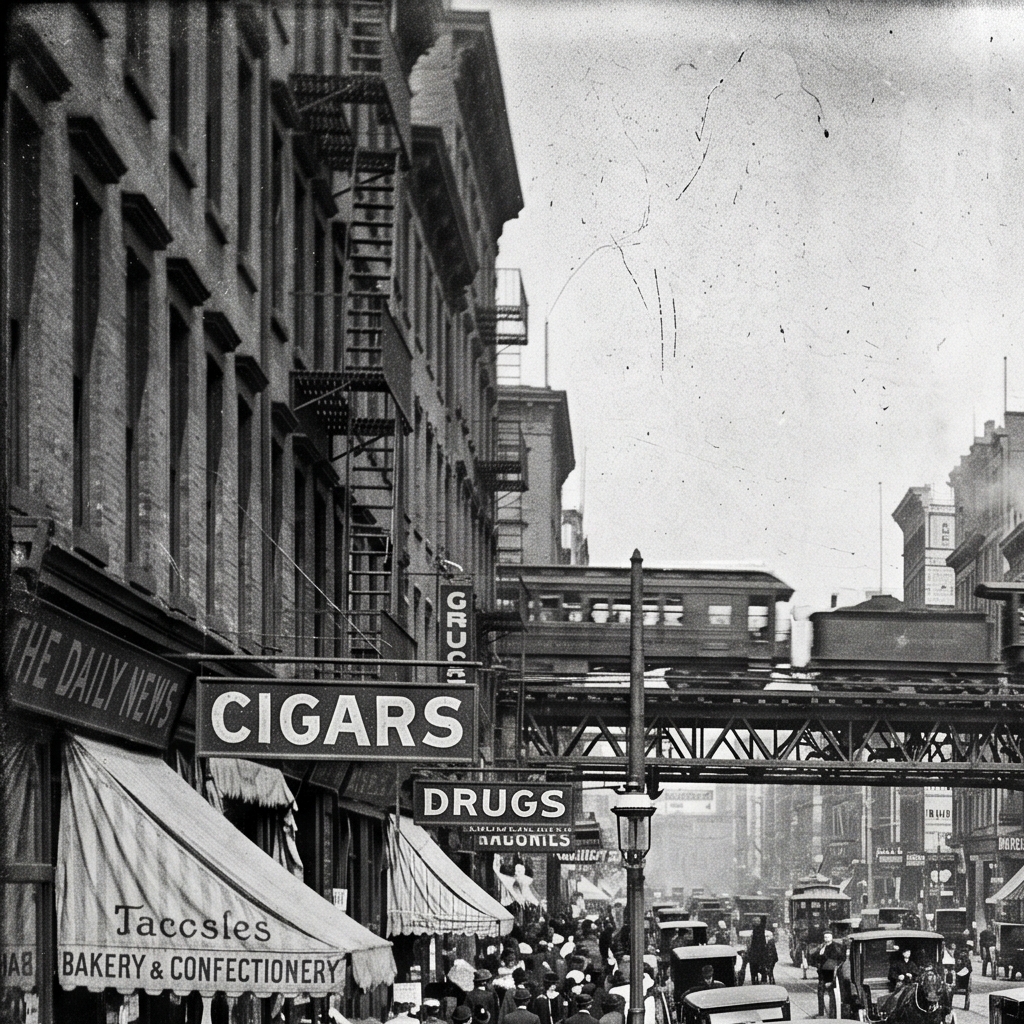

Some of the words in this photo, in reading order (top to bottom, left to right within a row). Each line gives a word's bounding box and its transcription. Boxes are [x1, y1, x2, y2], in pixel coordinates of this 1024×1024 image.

[5, 617, 63, 690] THE
[54, 639, 129, 711] DAILY
[118, 666, 179, 729] NEWS
[211, 691, 464, 748] CIGARS
[423, 787, 566, 818] DRUGS
[62, 952, 147, 979] BAKERY
[150, 960, 164, 980] &
[170, 956, 341, 984] CONFECTIONERY
